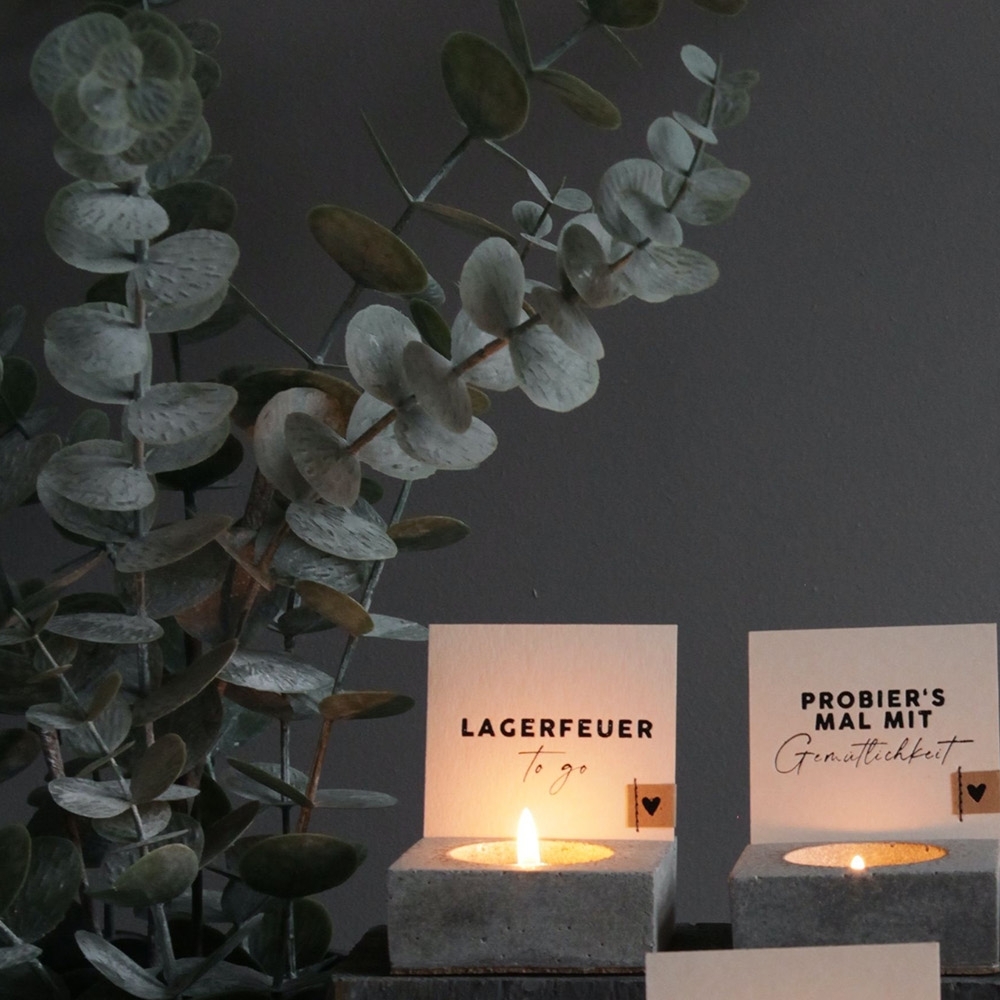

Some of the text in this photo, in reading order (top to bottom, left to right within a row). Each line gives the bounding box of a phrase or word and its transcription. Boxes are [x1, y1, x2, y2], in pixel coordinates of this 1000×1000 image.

[461, 717, 654, 738] LAGERFEUER
[815, 709, 933, 730] MAL MIT
[549, 762, 588, 795] go
